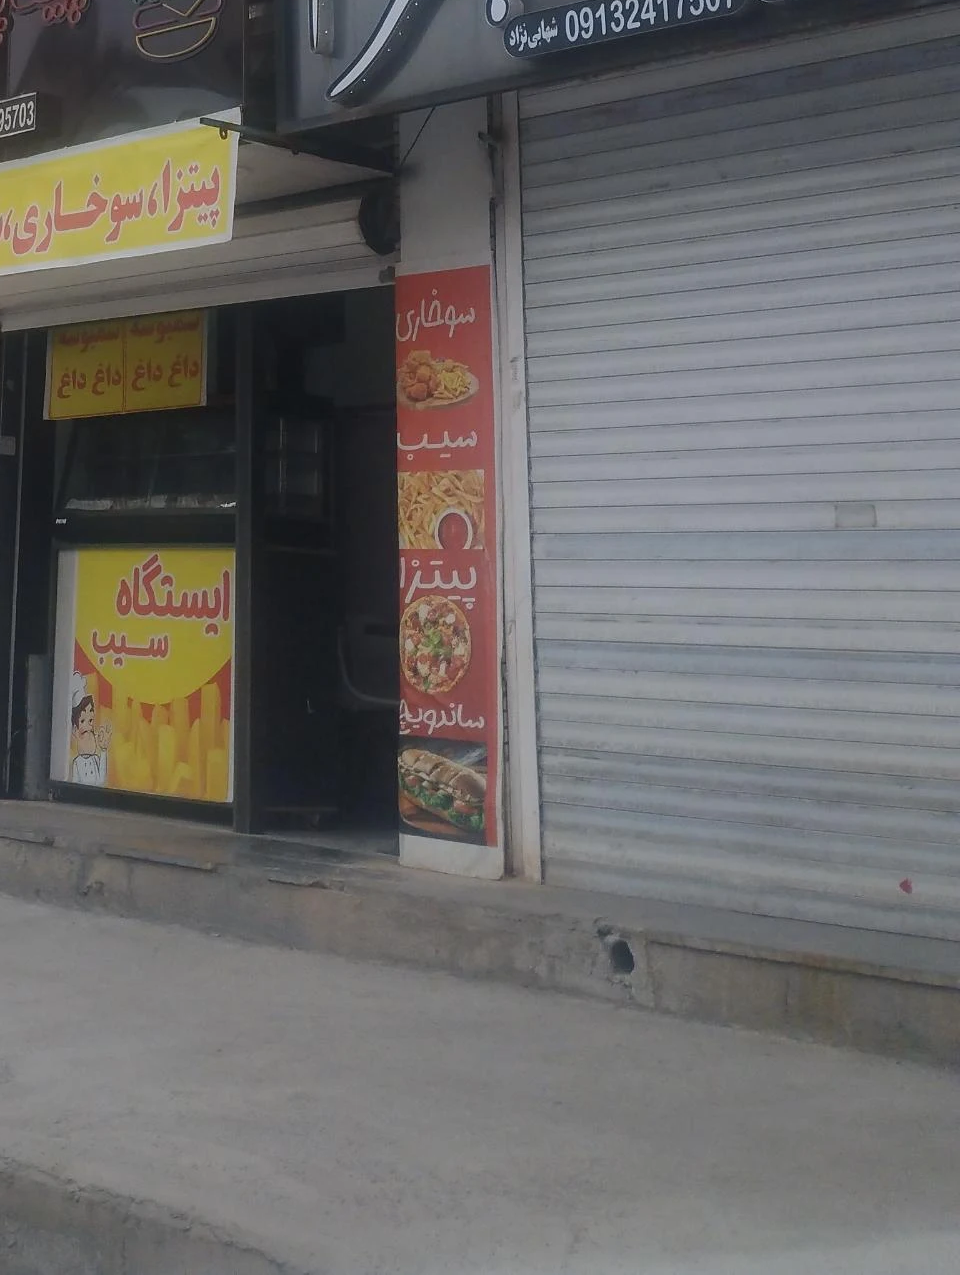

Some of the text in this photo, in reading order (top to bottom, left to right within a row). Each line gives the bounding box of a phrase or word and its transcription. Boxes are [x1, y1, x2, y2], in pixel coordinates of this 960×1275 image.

[395, 288, 477, 343] سوخاری
[56, 362, 122, 399] داغ داغ
[131, 357, 163, 392] داغ
[396, 429, 478, 462] سیب
[115, 553, 231, 636] ایستگاه
[399, 556, 478, 610] پیتزا
[91, 630, 170, 667] سیب
